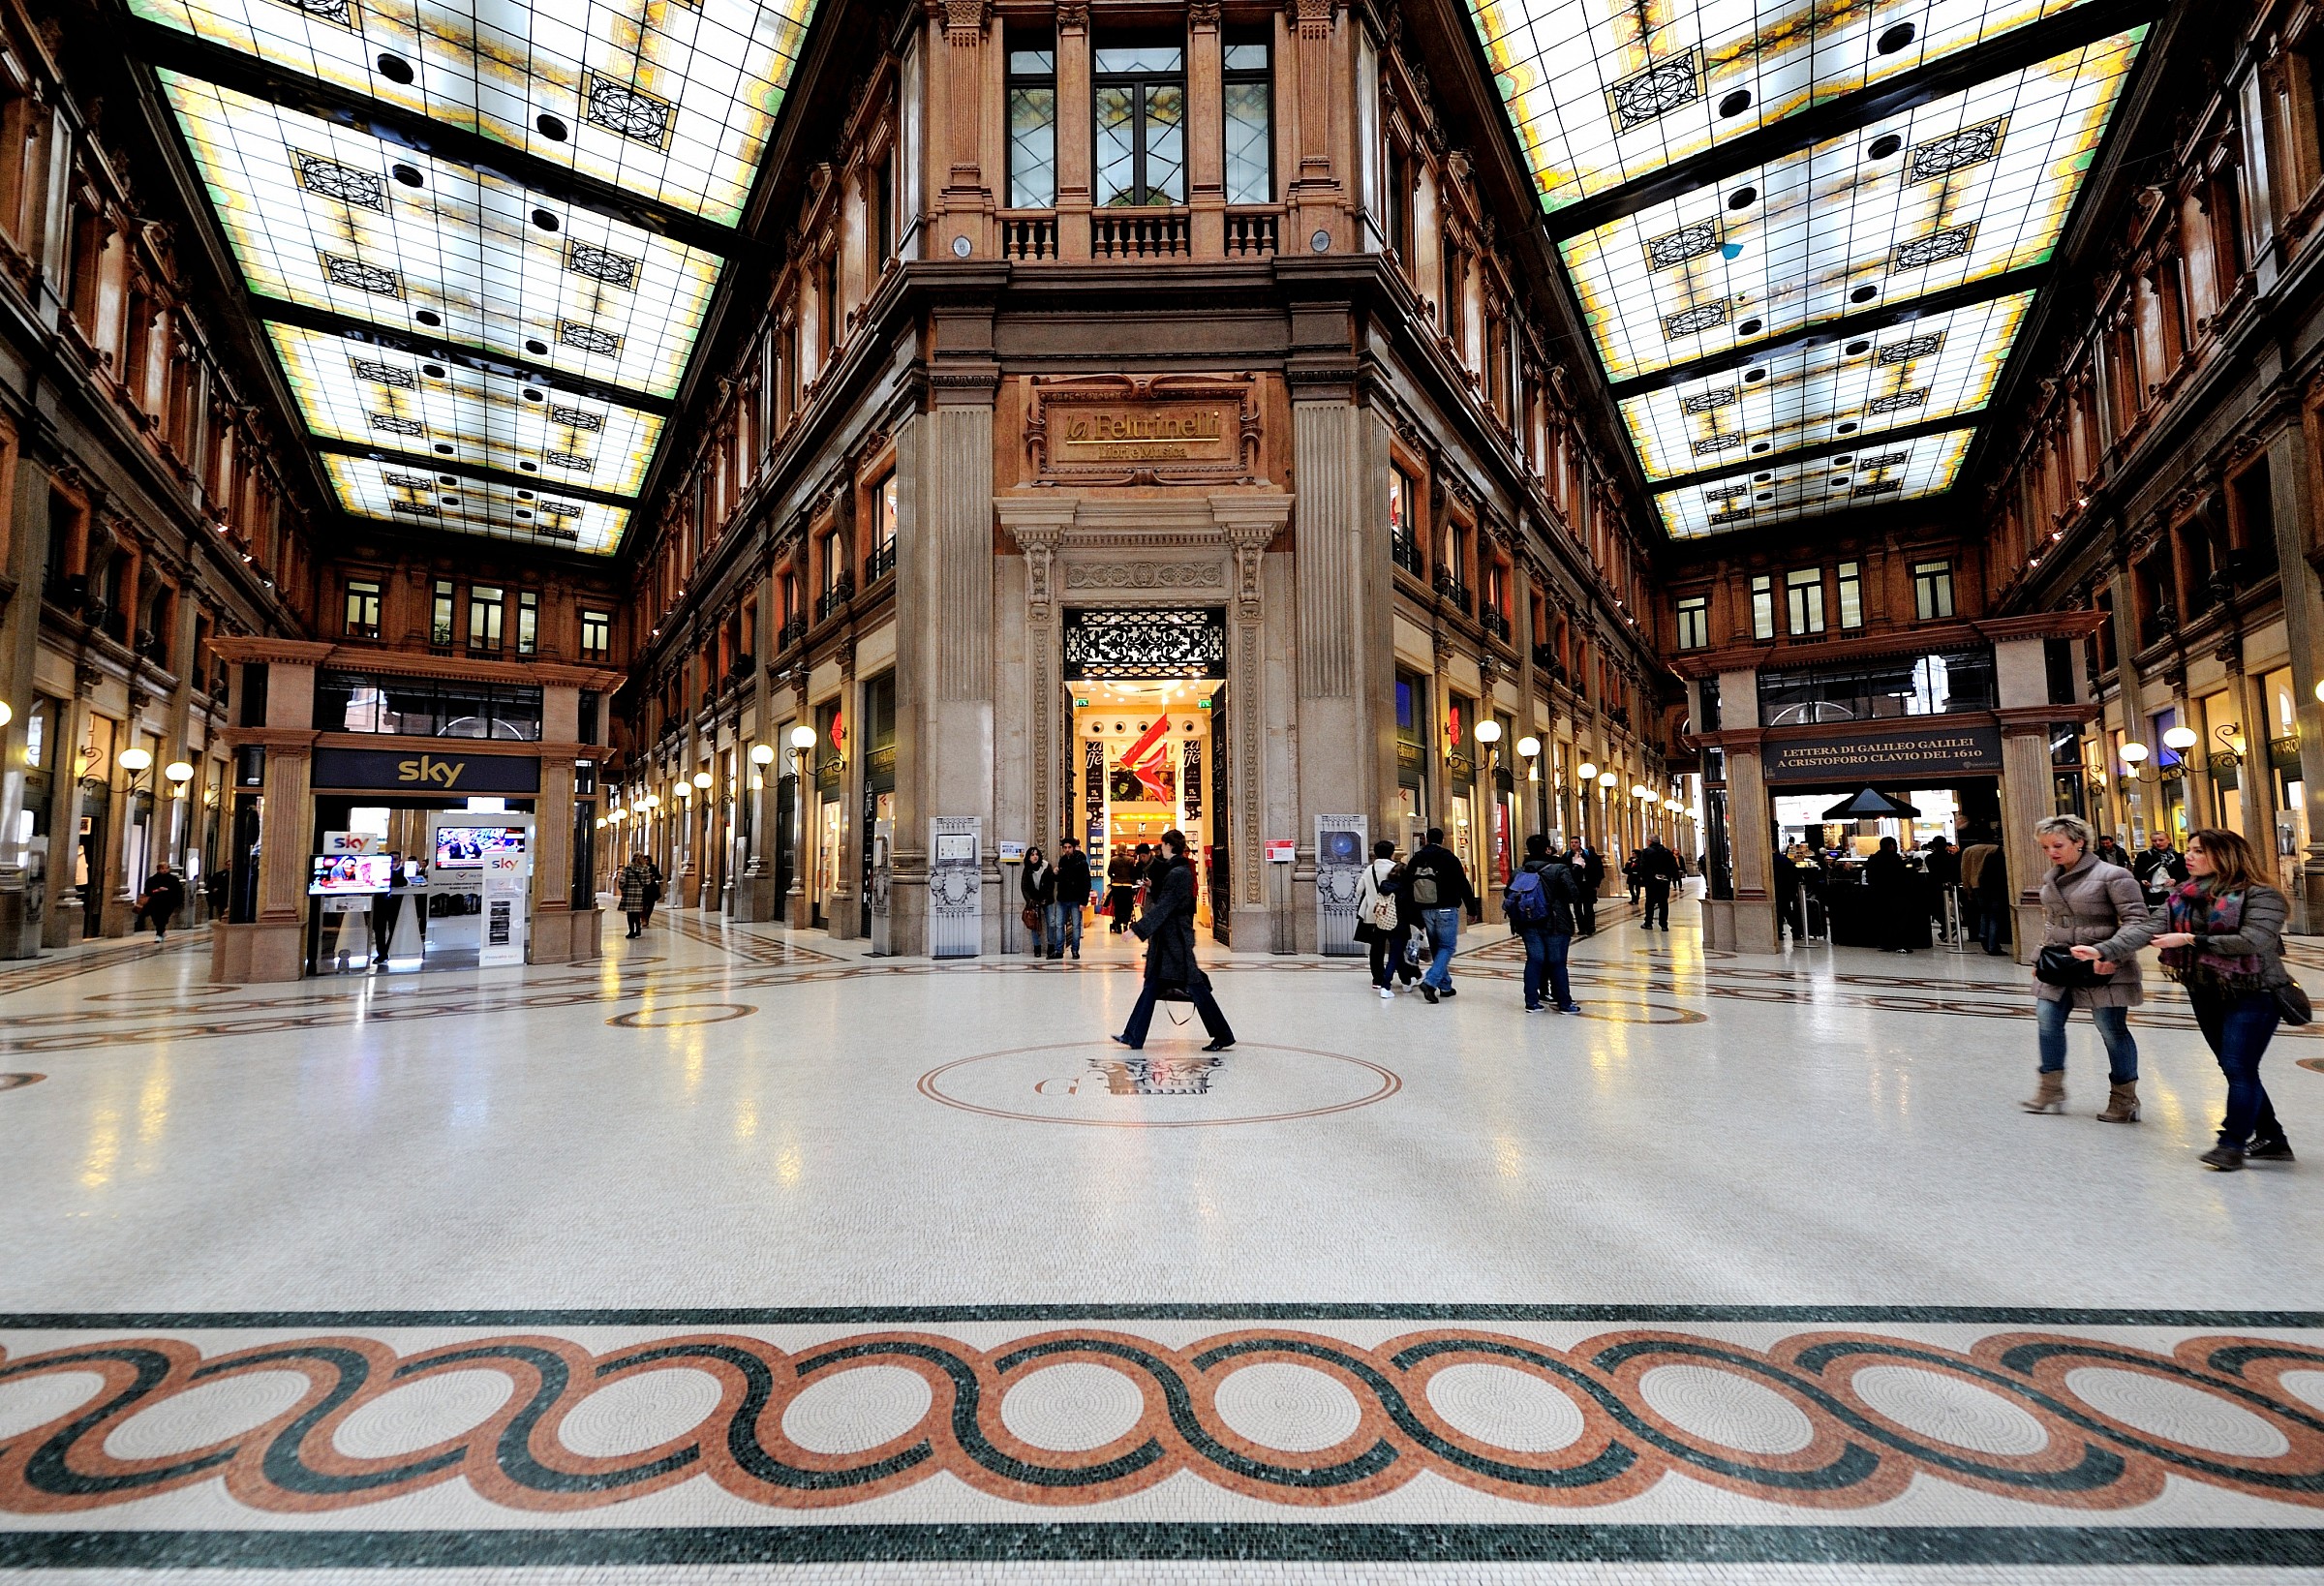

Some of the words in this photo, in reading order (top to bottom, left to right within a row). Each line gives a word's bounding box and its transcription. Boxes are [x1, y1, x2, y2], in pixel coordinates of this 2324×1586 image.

[1066, 414, 1088, 438] la
[1094, 411, 1220, 438] Feltrinelli
[1098, 445, 1129, 459] Libri
[1131, 448, 1139, 458] e
[1140, 444, 1187, 458] Musica
[1777, 759, 1787, 768] A
[1788, 754, 1868, 767] CRISTOFORO
[1870, 750, 1920, 763] CLAVIO
[1922, 749, 1951, 760] DEL
[1952, 748, 1983, 759] 1610
[1783, 747, 1838, 758] LETTERA
[1840, 745, 1855, 755] DI
[1857, 741, 1915, 753] GALILEO
[1917, 738, 1974, 750] GALILEI
[398, 755, 465, 788] sky
[334, 834, 369, 852] sky
[491, 857, 518, 870] sky
